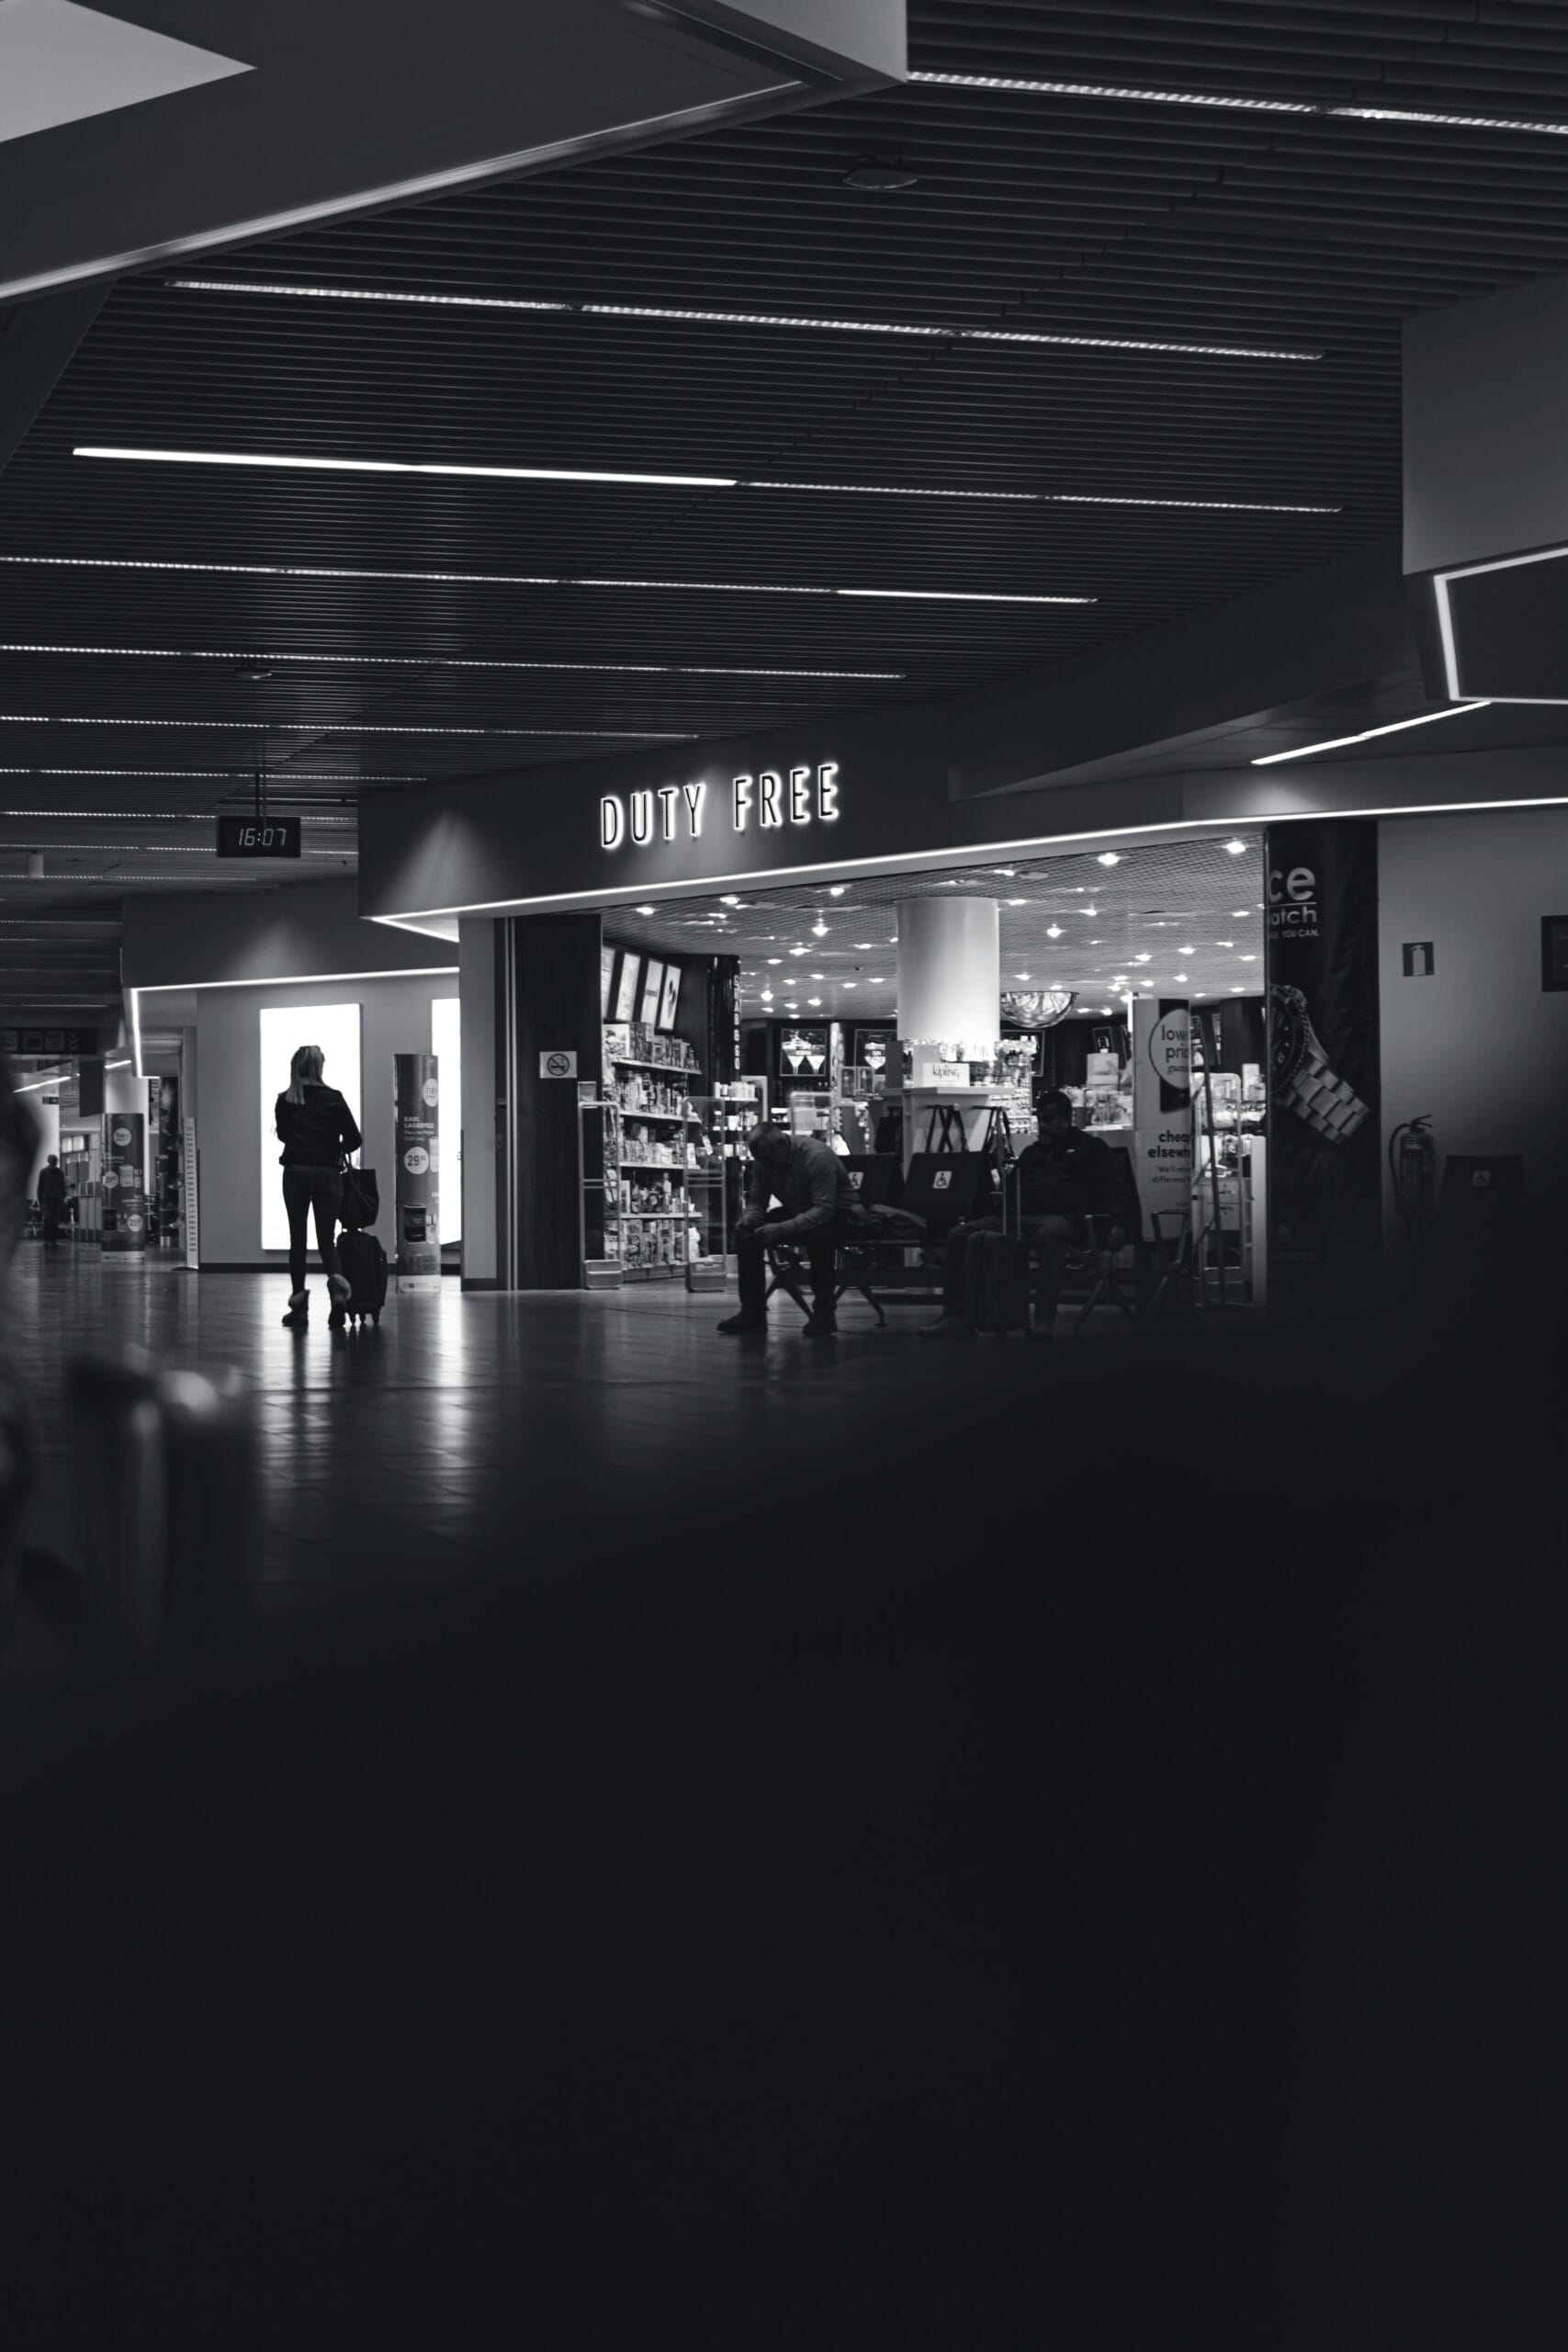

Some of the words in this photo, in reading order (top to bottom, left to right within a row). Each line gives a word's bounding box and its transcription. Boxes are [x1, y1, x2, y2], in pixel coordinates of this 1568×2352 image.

[600, 783, 706, 848] DUTY
[733, 763, 839, 831] FREE
[239, 828, 287, 845] 16:07
[1268, 906, 1317, 925] atch
